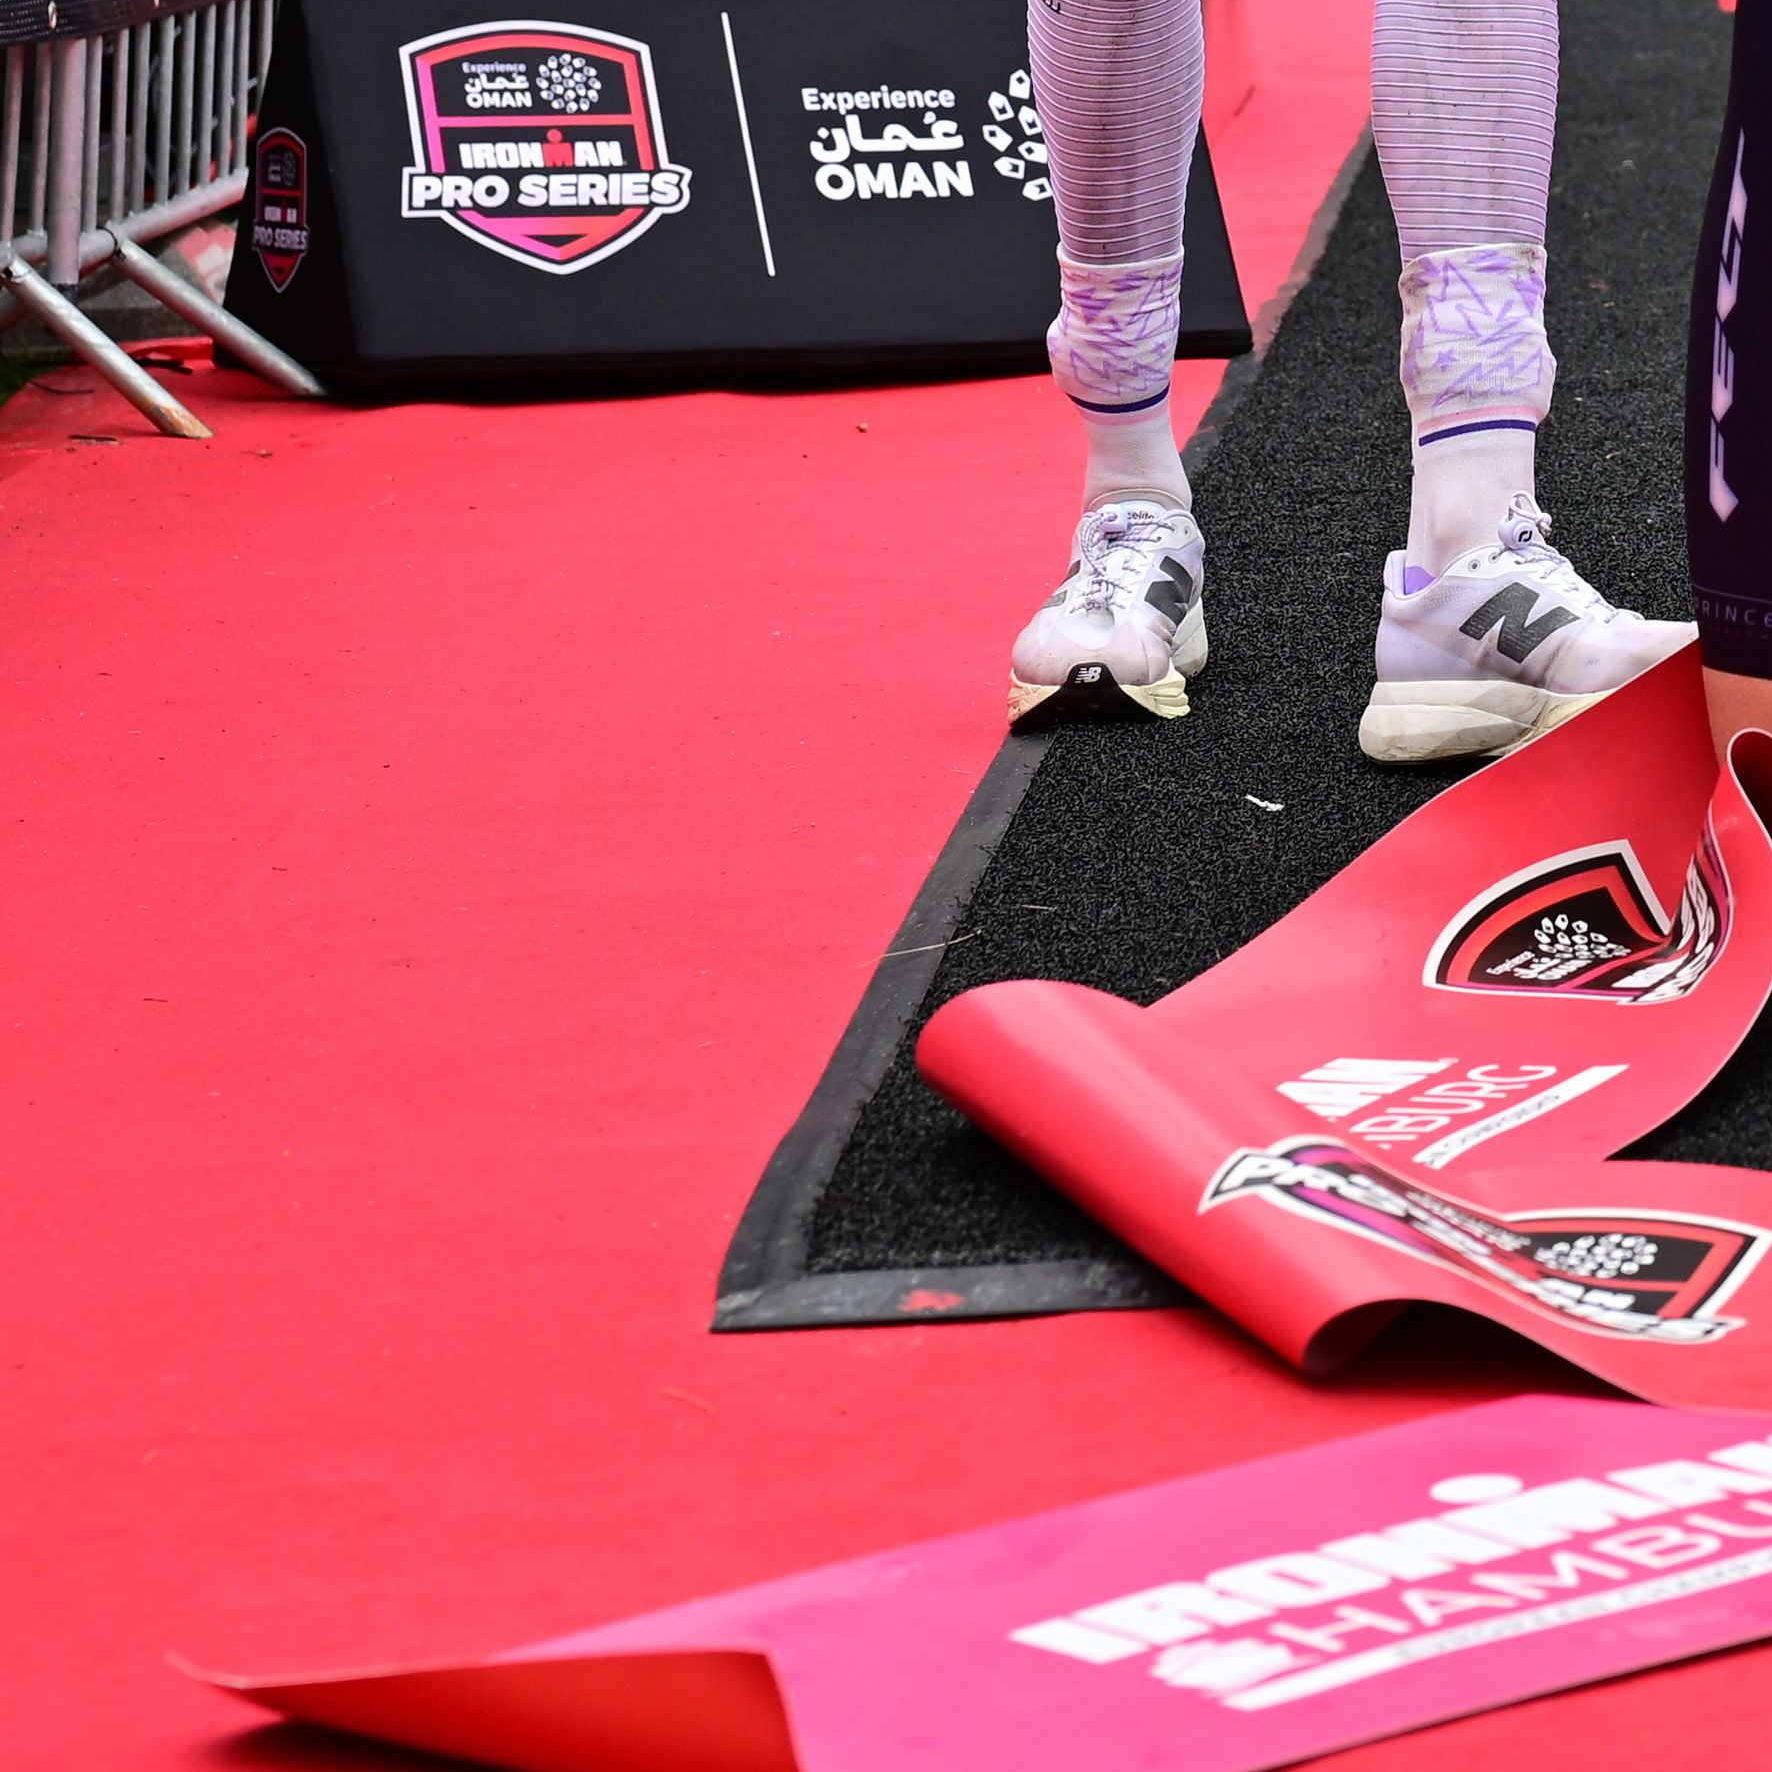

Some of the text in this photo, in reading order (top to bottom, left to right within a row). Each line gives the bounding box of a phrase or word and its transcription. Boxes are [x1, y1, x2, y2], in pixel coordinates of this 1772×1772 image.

[462, 61, 527, 77] Experience
[465, 91, 533, 110] OMAN
[801, 85, 956, 116] Experience
[459, 141, 622, 170] IRONMAN
[412, 173, 685, 209] PRO SERIES
[814, 160, 975, 201] OMAN
[1349, 1064, 1557, 1150] BURG
